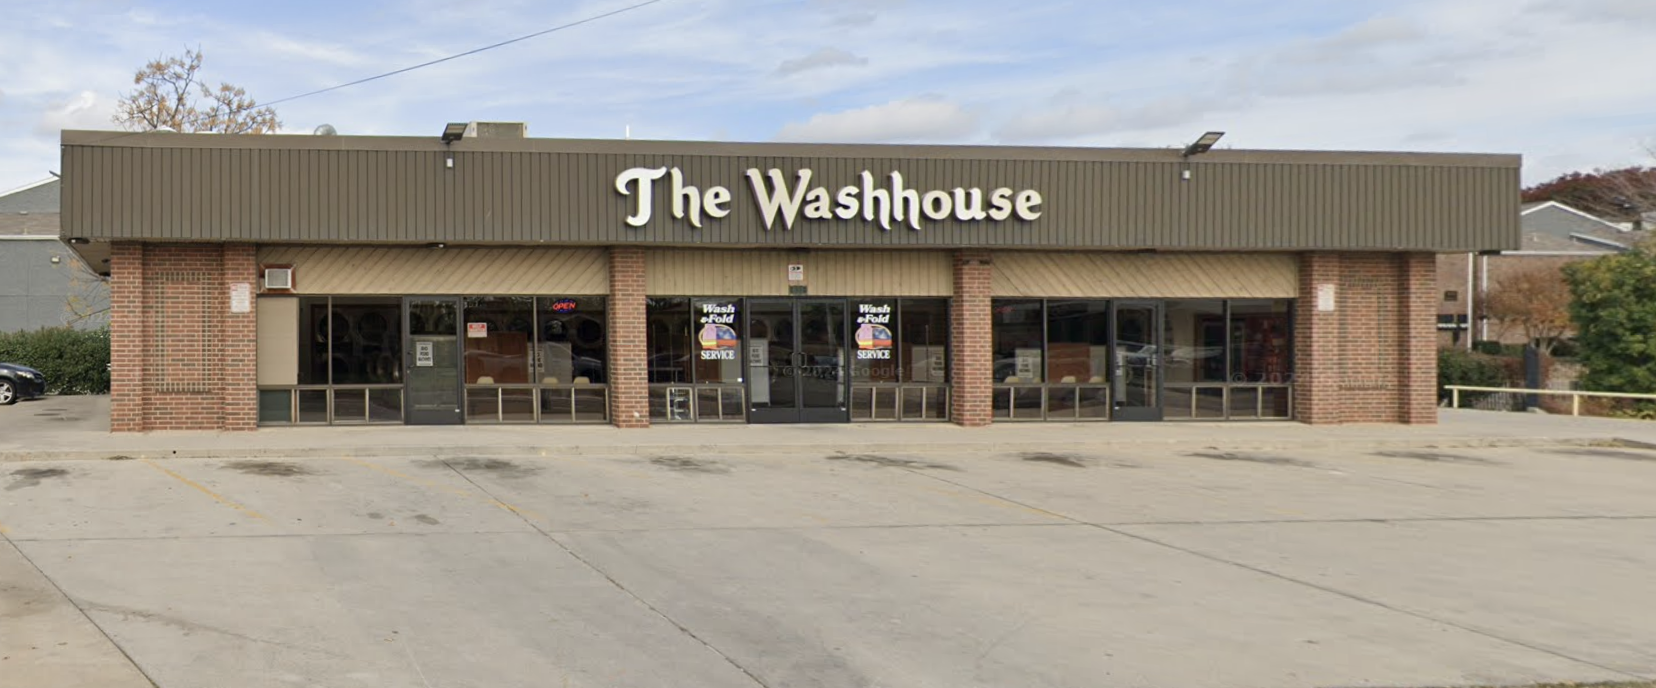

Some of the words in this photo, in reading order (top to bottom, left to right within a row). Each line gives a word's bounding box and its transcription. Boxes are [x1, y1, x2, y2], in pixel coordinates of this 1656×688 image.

[615, 165, 732, 228] The
[745, 167, 1043, 231] Washhouse
[552, 302, 576, 311] OPEN
[702, 303, 736, 314] Wash
[858, 303, 891, 314] Wash
[700, 349, 736, 360] SERVICE
[856, 349, 891, 360] SERVICE
